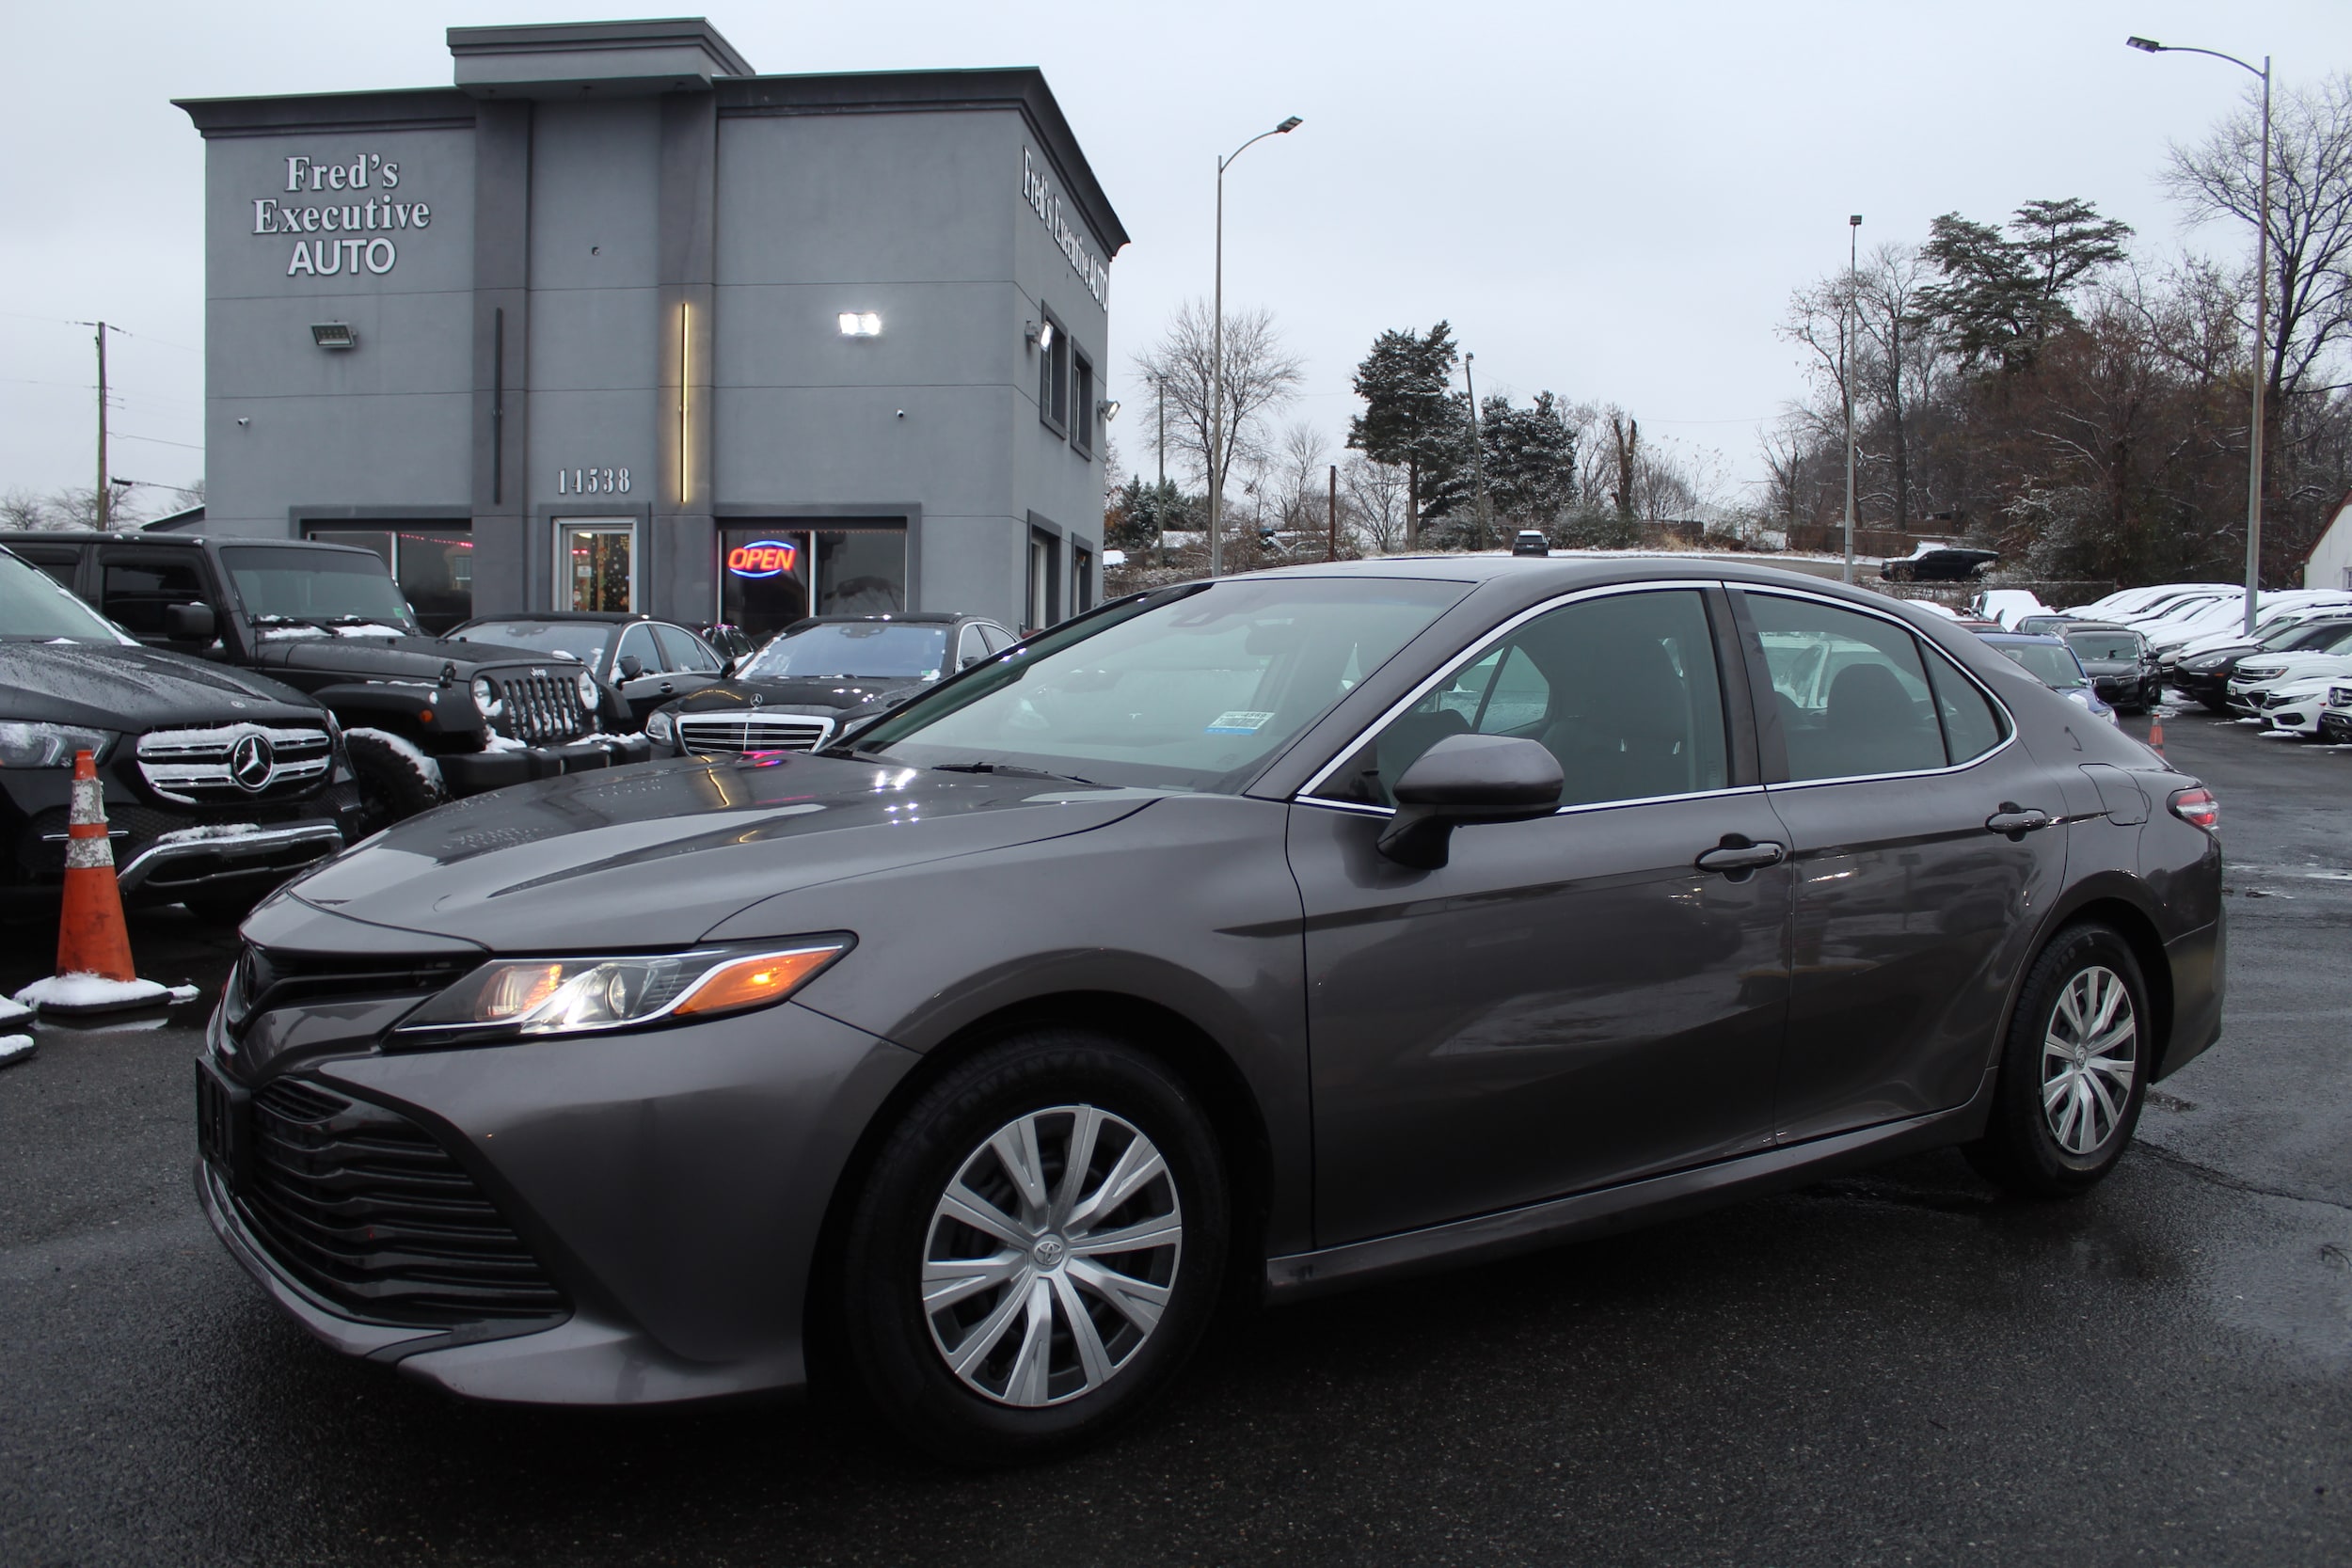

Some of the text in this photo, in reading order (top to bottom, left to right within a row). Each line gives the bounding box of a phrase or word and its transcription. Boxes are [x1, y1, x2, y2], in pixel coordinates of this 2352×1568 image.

[285, 153, 399, 191] Fred's
[252, 195, 431, 234] Executive
[1023, 146, 1052, 231] Fred's
[1089, 255, 1108, 312] AUTO
[287, 237, 396, 276] AUTO
[559, 467, 631, 494] 14538
[728, 546, 797, 571] OPEN
